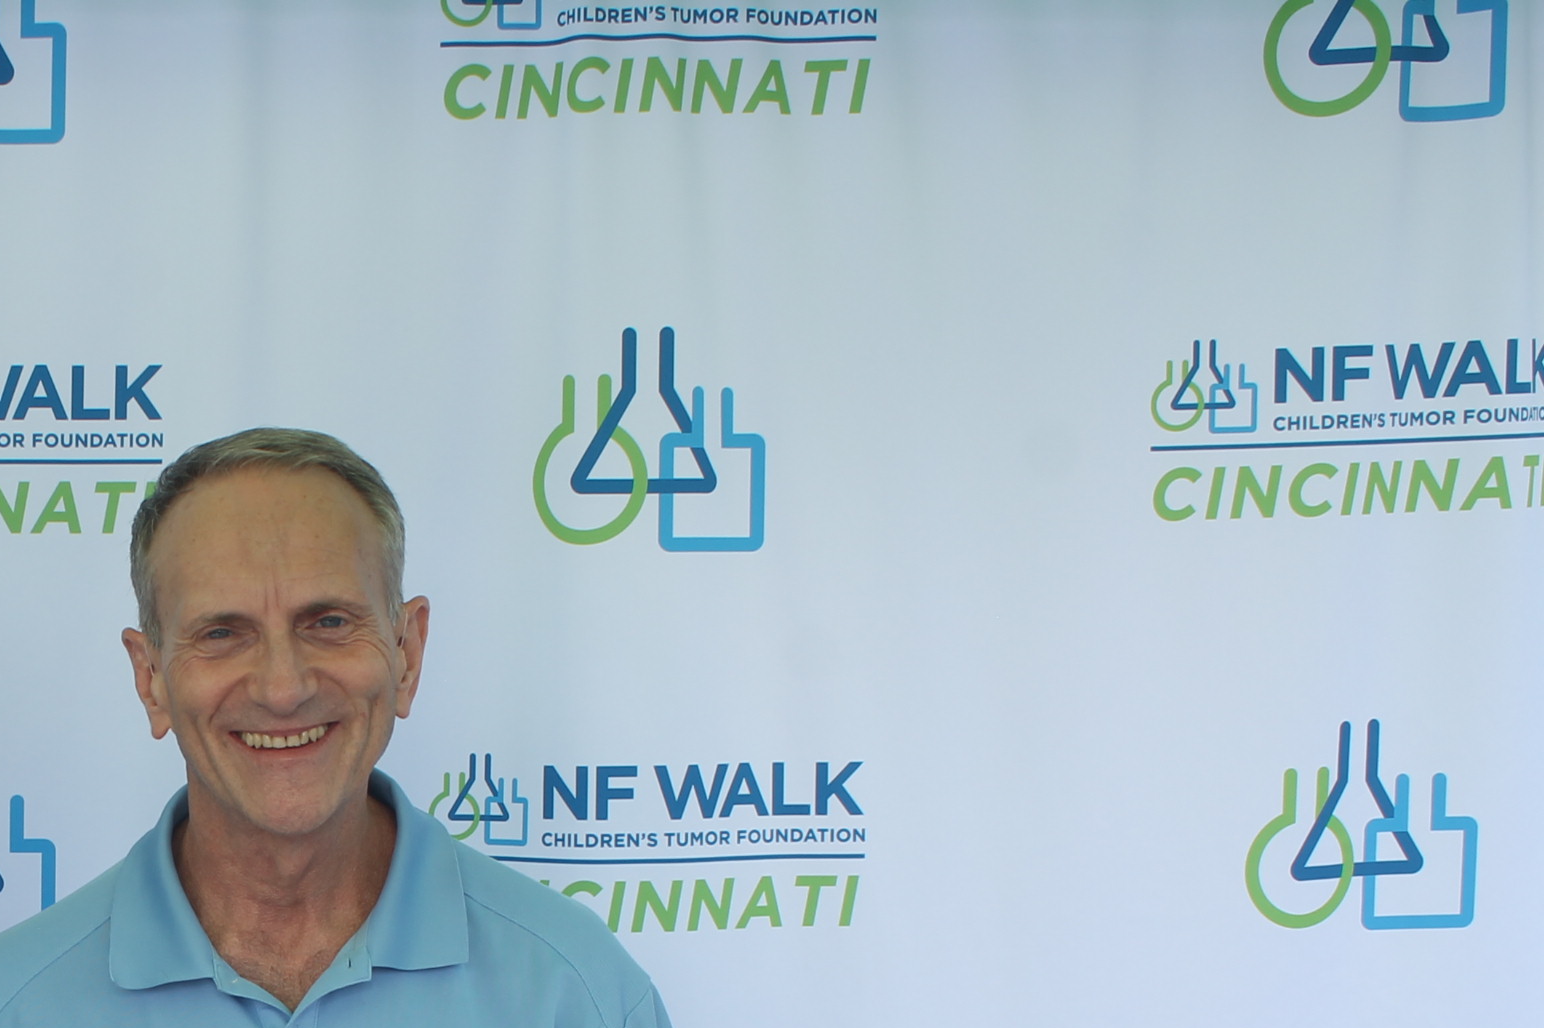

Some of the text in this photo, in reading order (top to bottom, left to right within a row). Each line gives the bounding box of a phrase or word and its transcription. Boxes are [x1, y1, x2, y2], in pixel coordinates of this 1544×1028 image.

[556, 6, 878, 28] CHILDREN'S TUMOR FOUNDATION
[443, 56, 871, 120] CINCINNATI
[1274, 344, 1374, 404] NF
[32, 432, 164, 449] FOUNDATION
[1272, 406, 1544, 432] CHILDREN'S TUMOR FOUNDATIO
[1152, 454, 1544, 522] CINCINNAT
[542, 761, 865, 822] NF WALK
[541, 827, 866, 849] CHILDREN'S TUMOR FOUNDATION
